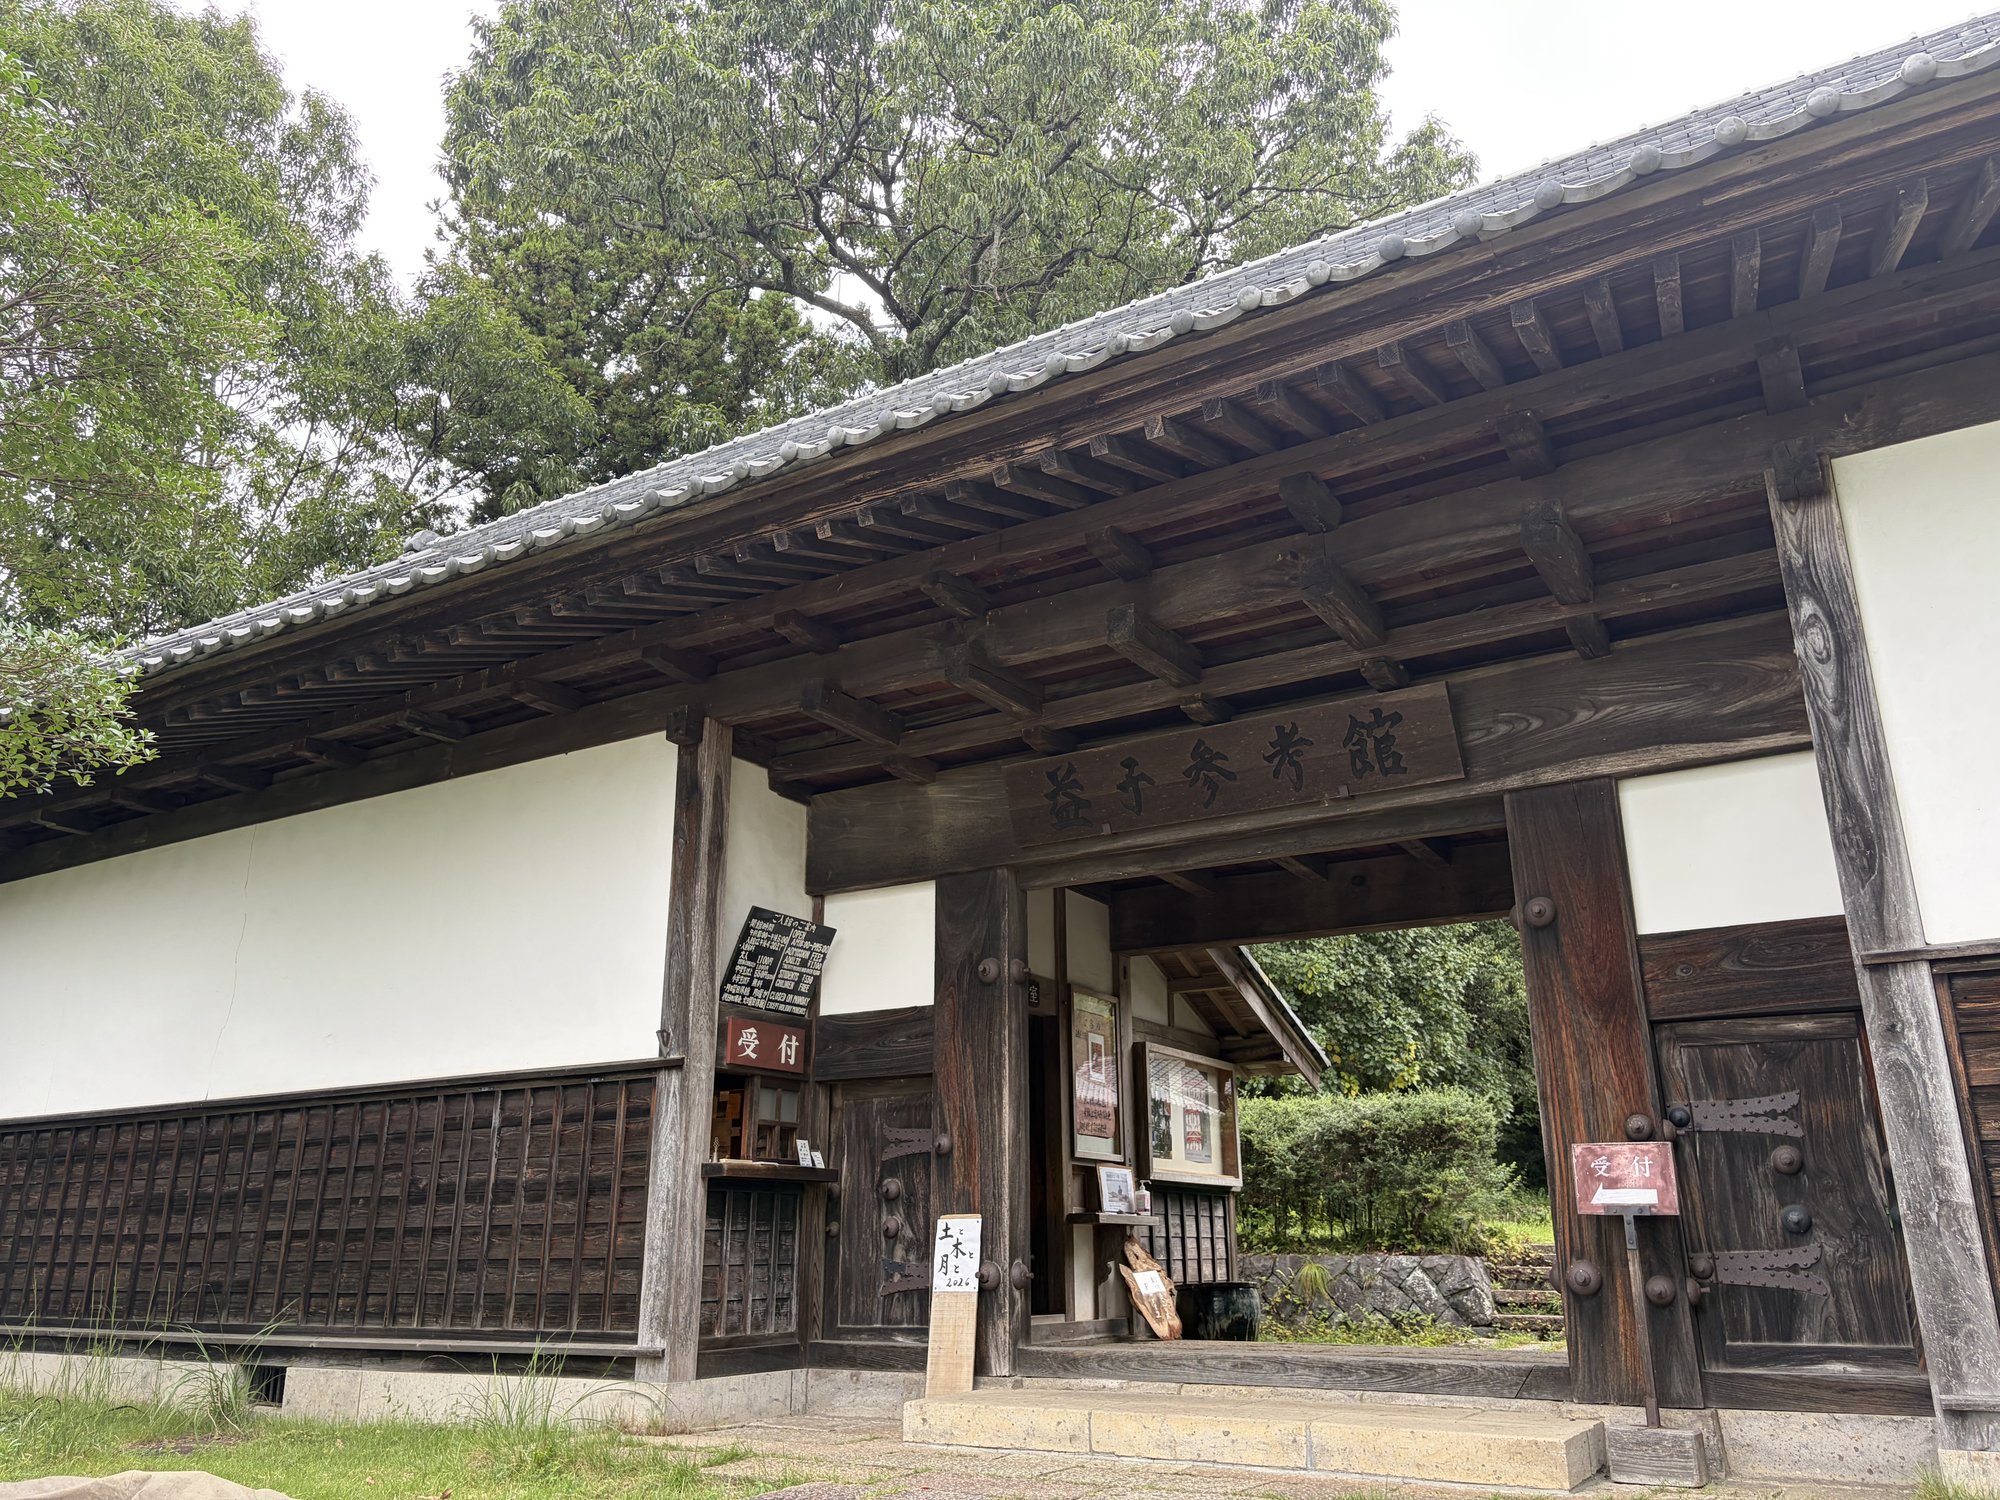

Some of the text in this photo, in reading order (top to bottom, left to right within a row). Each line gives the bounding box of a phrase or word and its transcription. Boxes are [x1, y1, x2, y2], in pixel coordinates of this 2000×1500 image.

[1043, 708, 1408, 830] 益子参考館
[772, 914, 816, 933] ご入館のご案内
[792, 930, 807, 940] OPEN
[783, 955, 801, 966] ADULTS
[811, 952, 824, 962] FEES
[778, 970, 800, 981] STUDENTS
[775, 979, 810, 993] CHILDREN FREE
[770, 991, 811, 1006] CLOSED ON MONDAY
[738, 1027, 799, 1065] 受付
[1590, 1156, 1653, 1177] 受付
[946, 1278, 970, 1287] 2026
